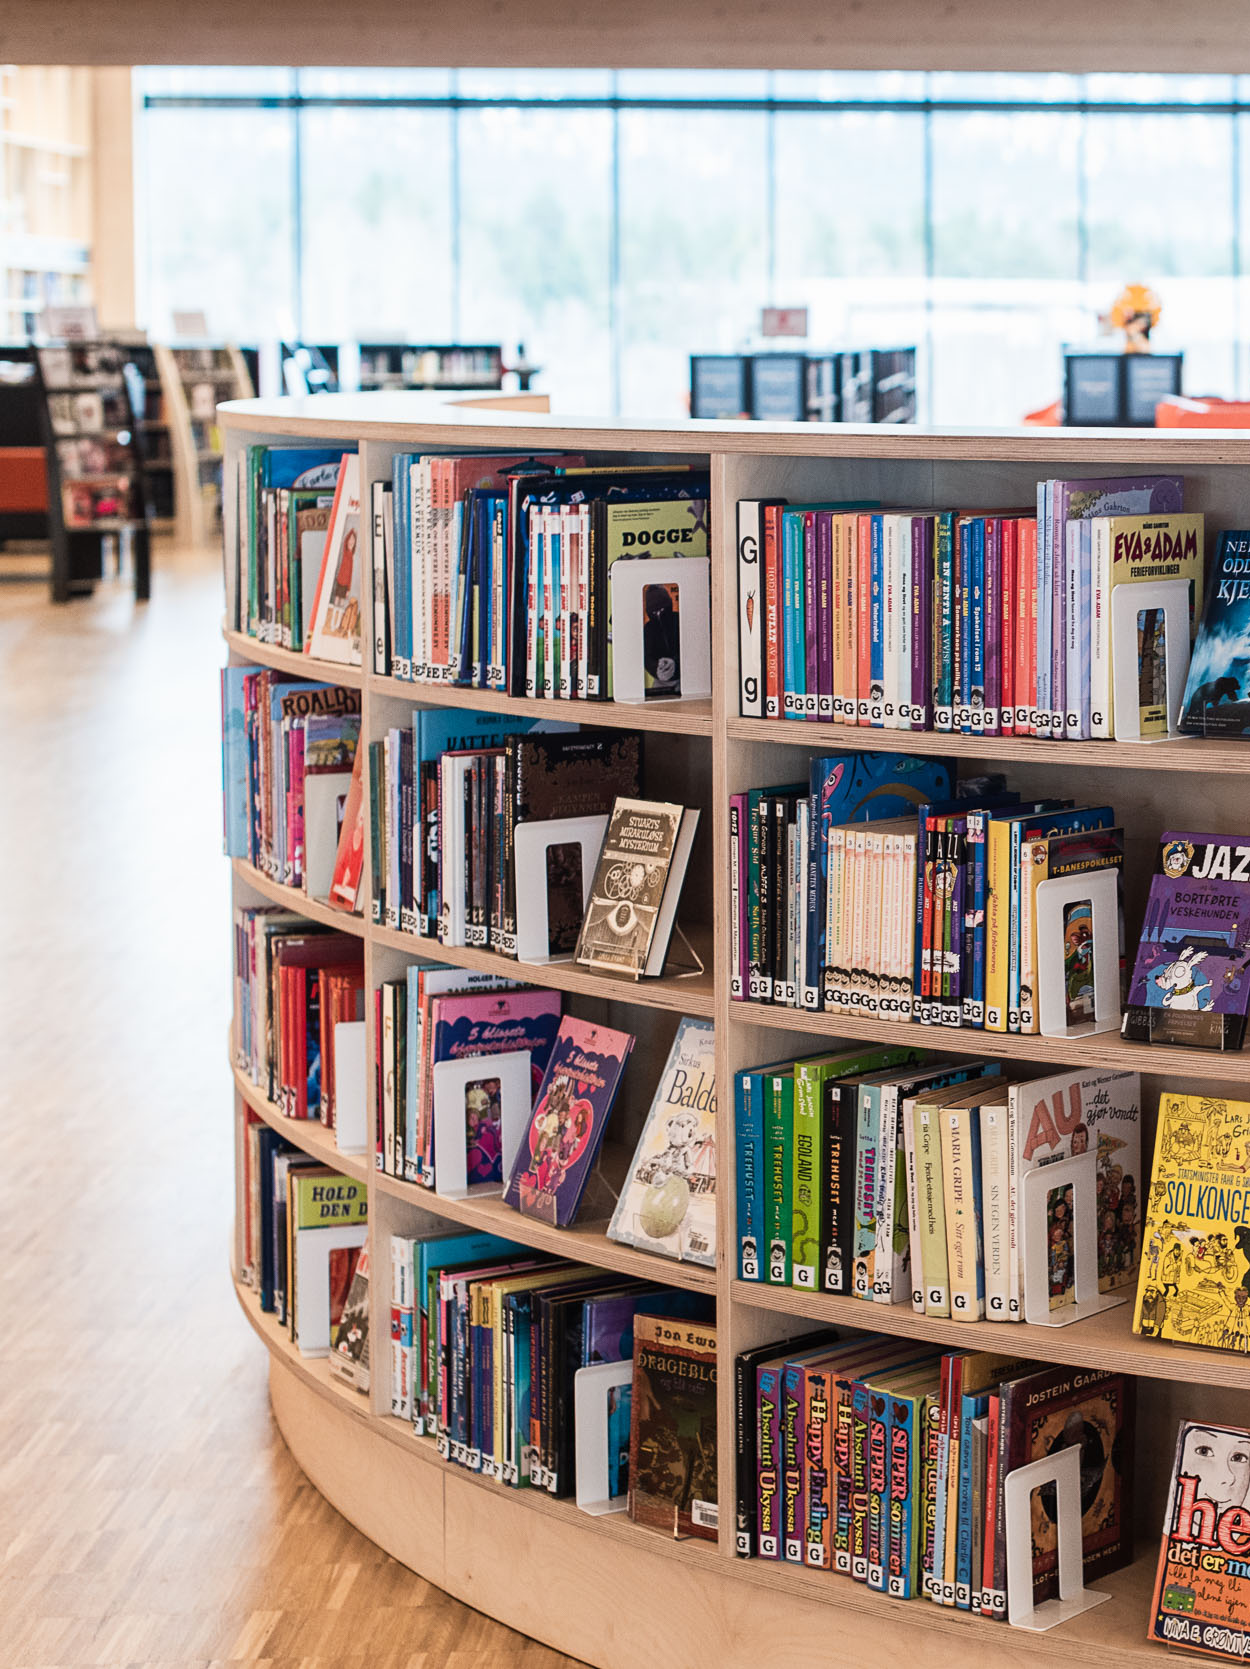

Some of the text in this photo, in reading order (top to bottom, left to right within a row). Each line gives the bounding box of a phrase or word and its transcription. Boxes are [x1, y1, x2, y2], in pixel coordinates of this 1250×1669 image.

[622, 528, 692, 547] DOGGE
[740, 536, 758, 564] G
[745, 677, 758, 702] g
[620, 826, 665, 841] MIRAKULØSE
[629, 816, 660, 828] STUARTS
[619, 838, 659, 851] MYSTERIUM
[1174, 892, 1241, 908] BORTFØRTE
[1170, 906, 1240, 920] VESKEHUNDEN
[679, 1053, 701, 1070] Sirkus
[1023, 1082, 1082, 1161] AU
[1087, 1104, 1139, 1126] gjør vondt
[798, 1134, 813, 1182] EGOLAND
[952, 1126, 963, 1205] MARIA GRIPE
[744, 1142, 755, 1201] TREHUSET
[830, 1143, 841, 1204] TREHUSET
[1178, 1168, 1219, 1183] STATSMINISTER
[312, 1186, 358, 1202] HOLD
[320, 1204, 352, 1218] DEN
[992, 1186, 1000, 1275] SIN EGEN VERDEN
[798, 1270, 808, 1282] G
[654, 1326, 681, 1342] Jon
[1026, 1383, 1070, 1407] JOSTEIN
[760, 1398, 778, 1532] Absolutt Ukyssa
[806, 1399, 828, 1544] Happy Ending
[890, 1426, 909, 1575] SUPER sommer
[1168, 1543, 1200, 1568] det
[1202, 1554, 1225, 1573] er
[1164, 1617, 1190, 1640] NINA
